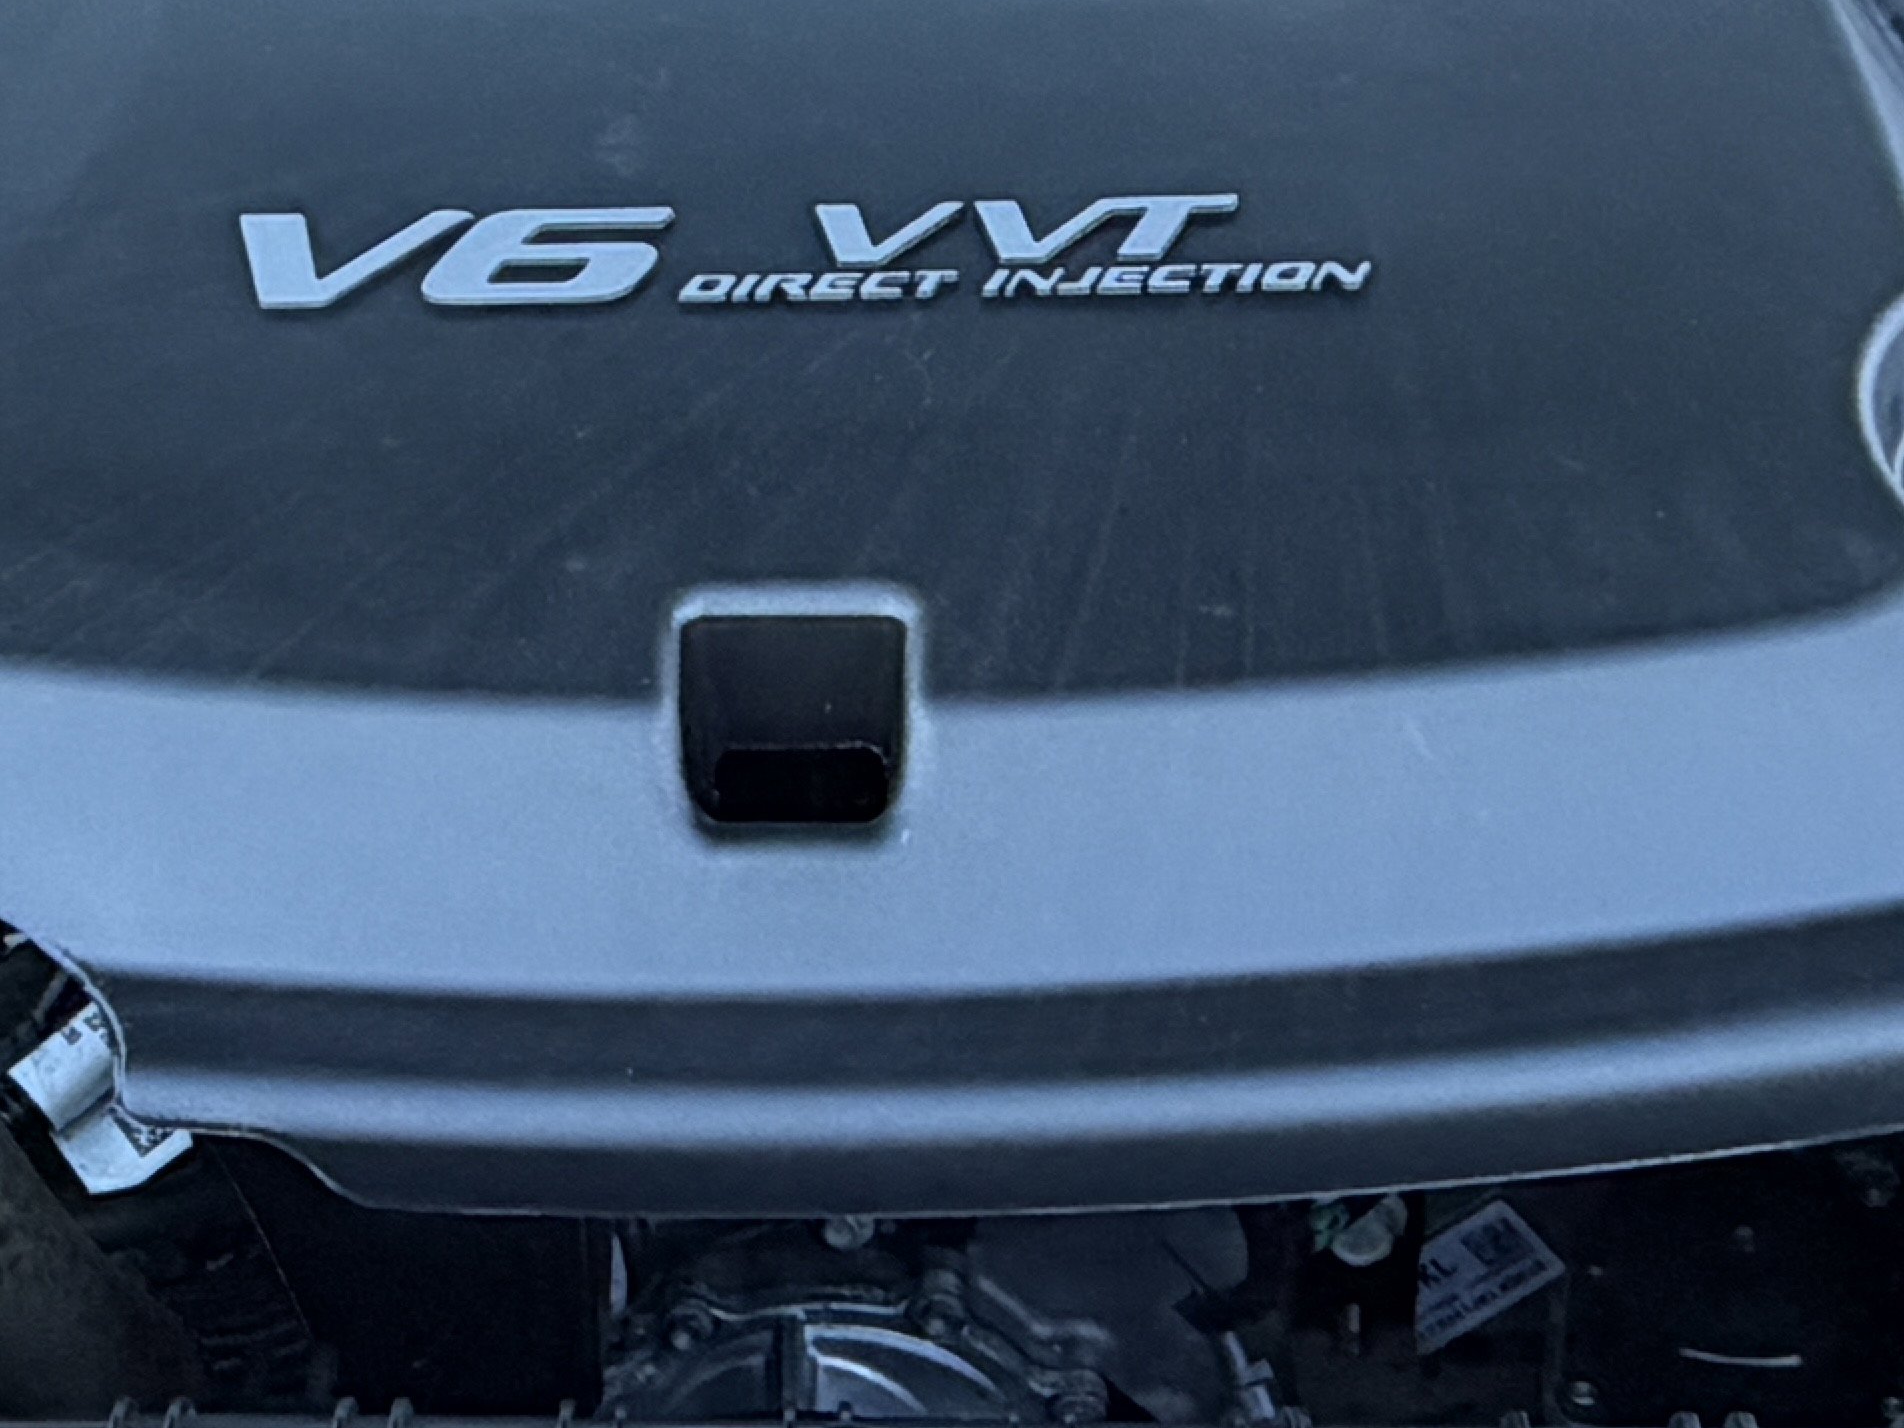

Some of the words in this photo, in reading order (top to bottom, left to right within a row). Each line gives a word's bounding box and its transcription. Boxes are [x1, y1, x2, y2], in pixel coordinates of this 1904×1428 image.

[239, 204, 675, 309] V6
[815, 192, 1238, 267] VVT
[678, 267, 960, 303] DIRECT
[982, 259, 1372, 300] INJECTION
